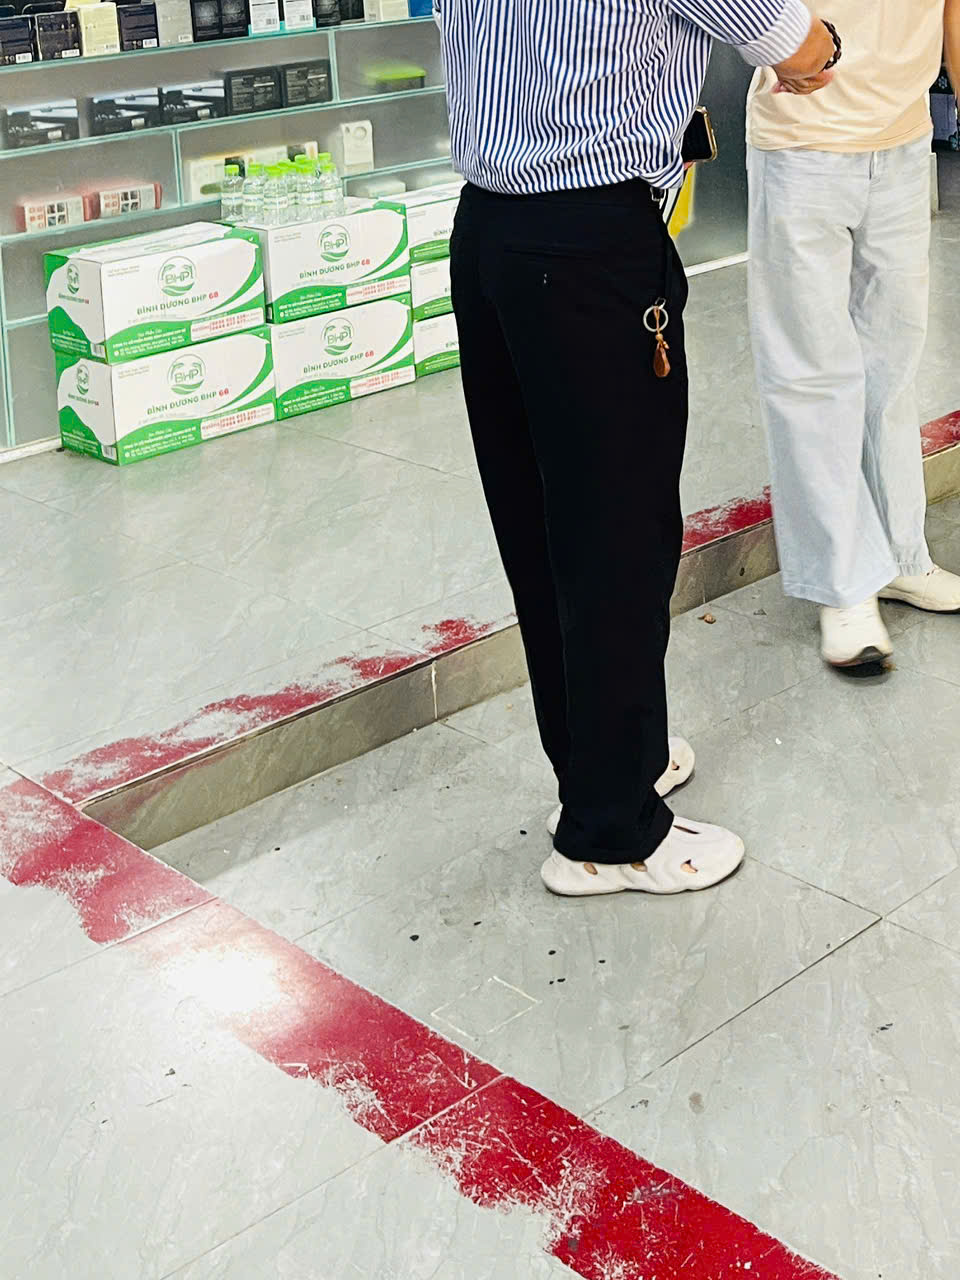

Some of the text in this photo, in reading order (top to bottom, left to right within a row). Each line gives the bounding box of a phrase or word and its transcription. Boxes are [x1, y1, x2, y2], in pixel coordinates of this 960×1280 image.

[165, 271, 190, 284] BHP
[137, 303, 158, 315] BÌNH
[160, 297, 190, 311] DƯƠNG
[191, 294, 207, 303] BHP
[174, 369, 199, 383] BHP
[147, 404, 168, 415] BÌNH
[169, 396, 199, 410] DƯƠNG
